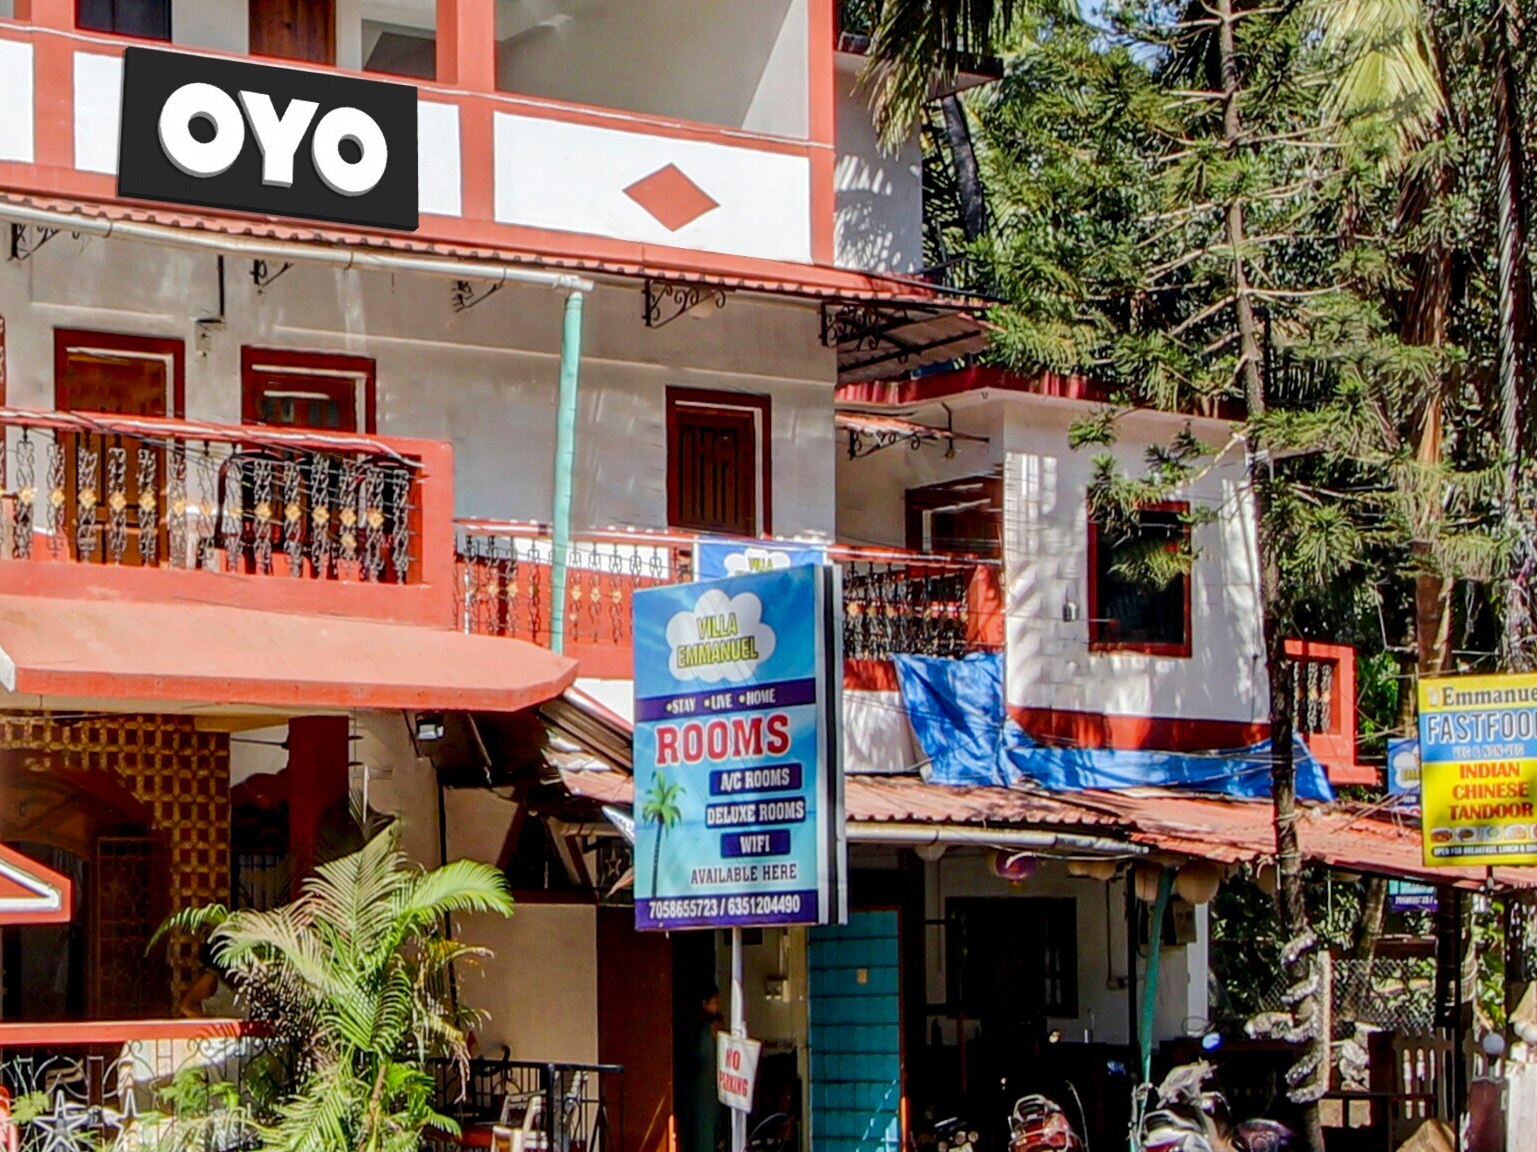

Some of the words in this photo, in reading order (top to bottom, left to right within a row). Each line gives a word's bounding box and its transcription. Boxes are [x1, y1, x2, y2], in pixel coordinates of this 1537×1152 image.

[158, 82, 388, 196] OYO
[697, 612, 738, 640] VILLA
[677, 636, 759, 668] EMMANUEL
[672, 697, 697, 714] STAY
[711, 693, 733, 710] LIVE
[746, 688, 776, 706] HOME
[656, 713, 790, 764] ROOMS
[720, 774, 742, 792] A/C
[745, 768, 790, 788] ROOMS
[1459, 762, 1521, 779] INDIAN
[1451, 781, 1530, 801] CHINESE
[707, 804, 756, 825] DELUXE
[759, 801, 804, 821] ROOMS
[1448, 802, 1534, 821] TANDOOR
[739, 835, 771, 854] WIFI
[690, 864, 758, 885] AVAILABLE
[763, 863, 797, 881] HERE
[649, 898, 718, 919] 7058655723
[727, 894, 801, 916] 6351204490
[725, 1048, 741, 1071] NO
[719, 1070, 748, 1098] PARKING
